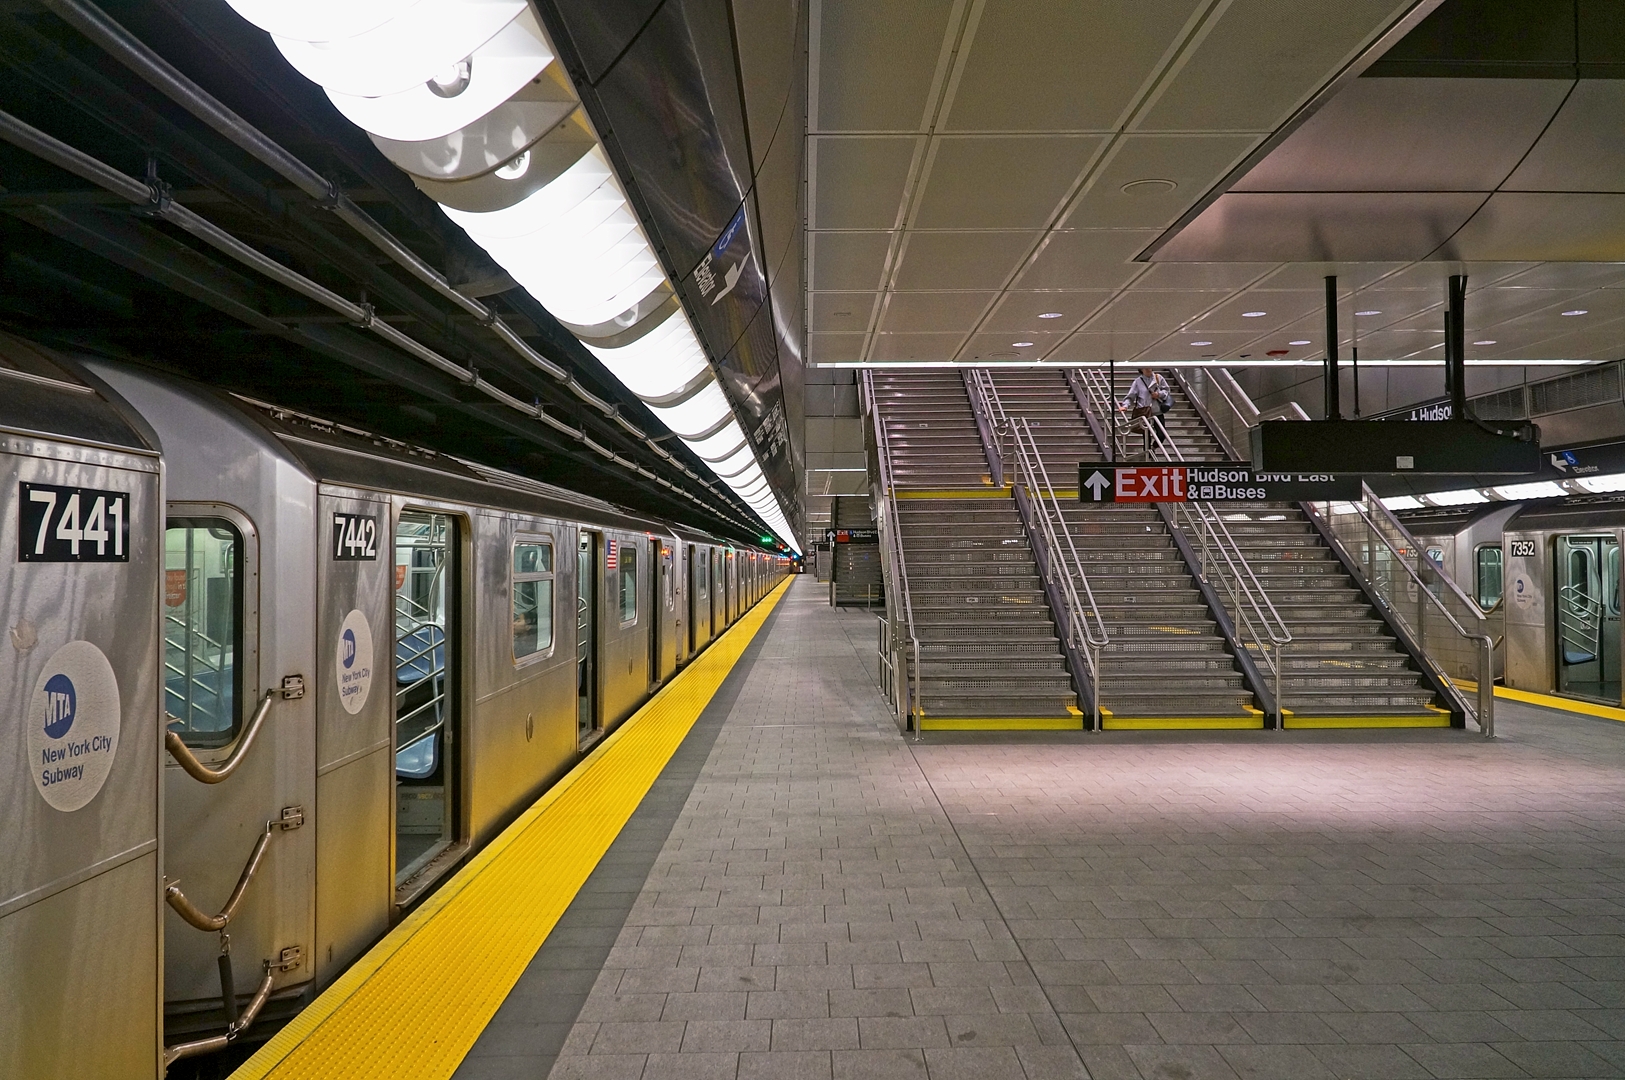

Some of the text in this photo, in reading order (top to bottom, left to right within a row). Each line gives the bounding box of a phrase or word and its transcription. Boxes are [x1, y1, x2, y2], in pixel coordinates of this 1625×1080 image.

[1115, 468, 1183, 497] Exit
[1187, 468, 1249, 483] Hudson
[1187, 485, 1266, 499] & Buses
[29, 489, 123, 556] 7441
[335, 516, 376, 557] 7442
[1511, 541, 1535, 556] 7352
[361, 668, 370, 679] City
[342, 685, 360, 697] Subway
[44, 690, 71, 729] MTA
[42, 735, 112, 765] New York City
[42, 764, 84, 787] Subway
